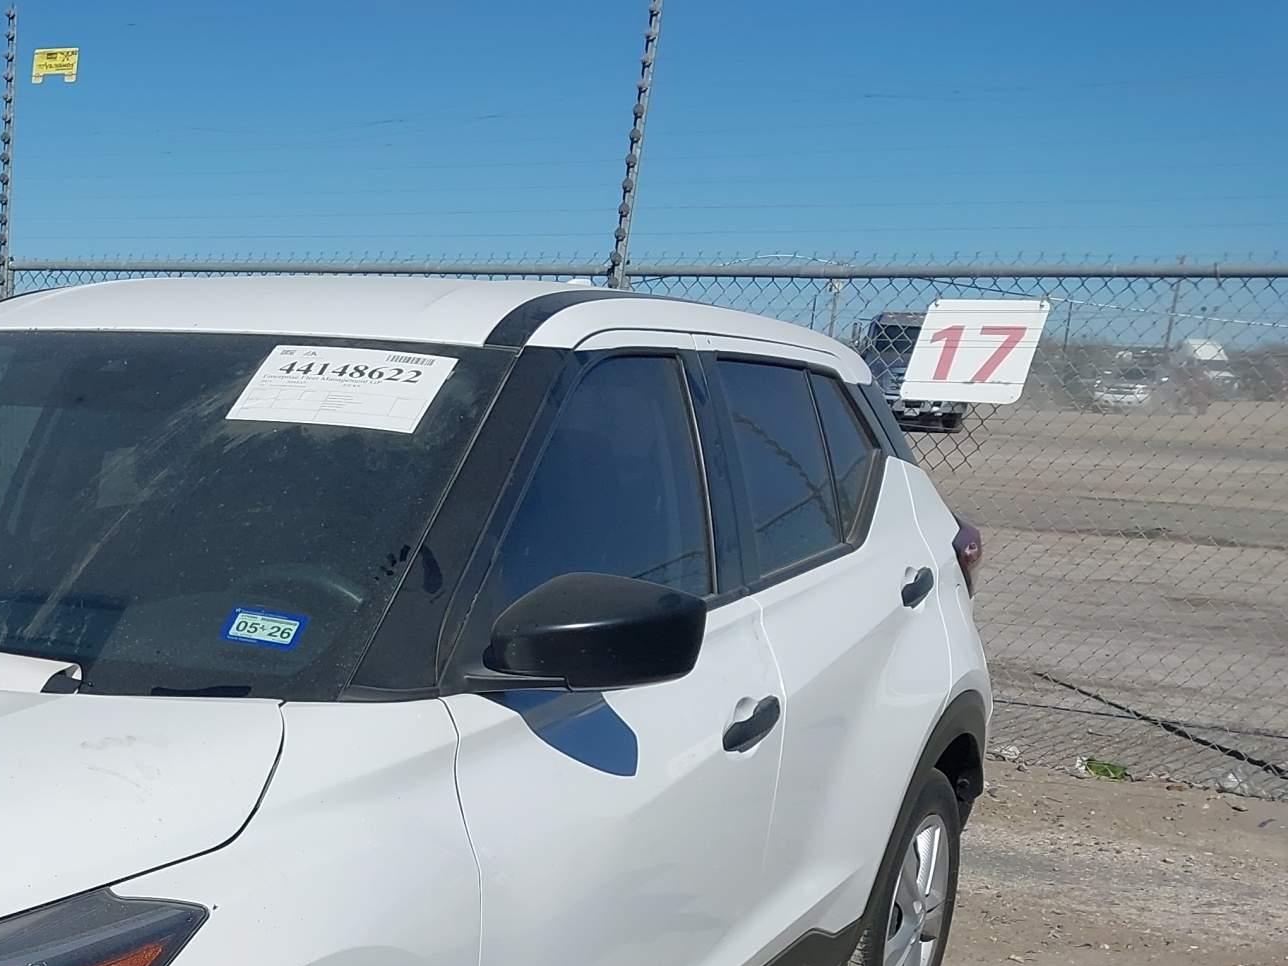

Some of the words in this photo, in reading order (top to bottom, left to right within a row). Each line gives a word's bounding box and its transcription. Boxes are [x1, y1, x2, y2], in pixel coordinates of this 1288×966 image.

[930, 325, 1027, 383] 17
[279, 360, 423, 384] 44148622
[236, 620, 260, 634] 05
[267, 625, 293, 639] 26
